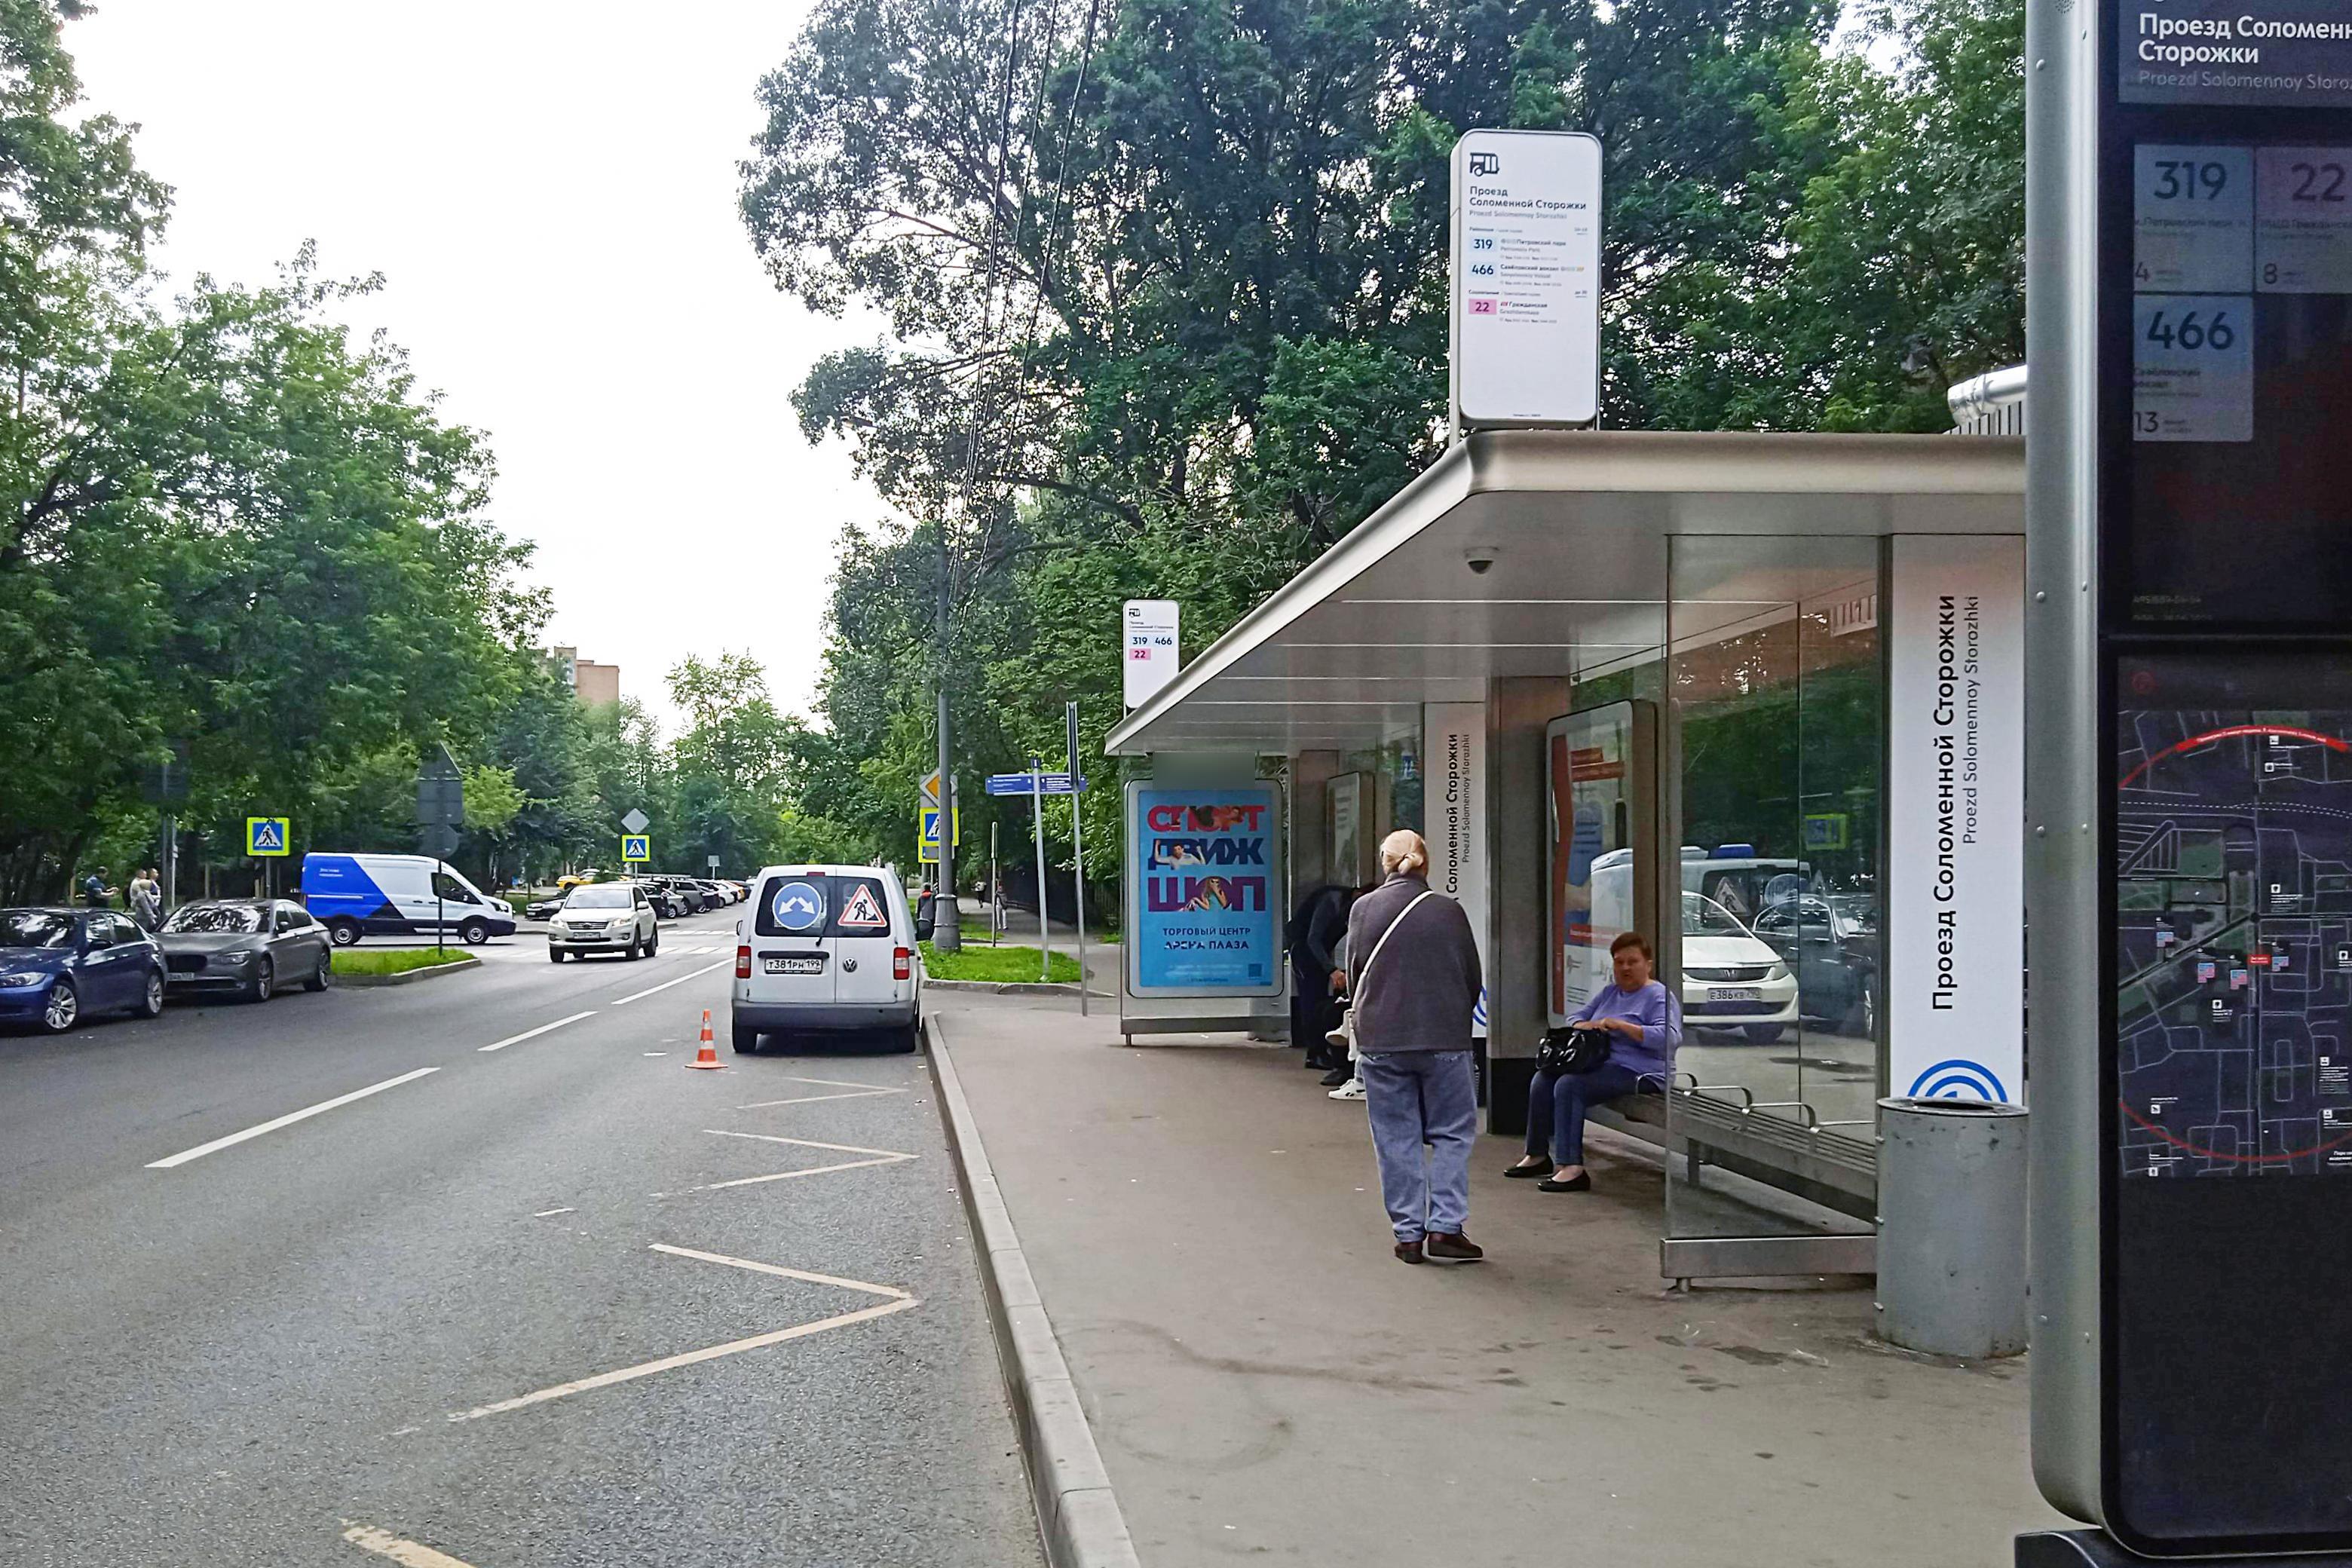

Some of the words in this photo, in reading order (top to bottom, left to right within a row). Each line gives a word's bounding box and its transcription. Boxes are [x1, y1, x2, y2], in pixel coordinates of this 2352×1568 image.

[2139, 13, 2231, 40] Проезд
[2138, 39, 2259, 66] Сторожки
[2139, 70, 2197, 87] Proezd
[2202, 71, 2303, 92] Solomennoy
[1470, 186, 1508, 197] Проезд
[2154, 161, 2228, 200] 319
[2290, 162, 2346, 202] 22
[1469, 197, 1533, 207] Соломенной
[1536, 200, 1586, 210] Сторожки
[1474, 239, 1493, 250] 319
[1472, 265, 1493, 275] 466
[2134, 262, 2149, 282] 4
[2263, 263, 2278, 284] 8
[1475, 302, 1490, 312] 22
[2147, 311, 2235, 350] 466
[2133, 412, 2160, 433] 13
[1132, 636, 1147, 645] 319
[1155, 637, 1172, 645] 466
[1963, 596, 1978, 674] Storozhki
[1135, 651, 1145, 659] 22
[1933, 595, 1958, 726] Сторожки
[1963, 680, 1982, 782] Solomennoy
[1446, 734, 1460, 802] Сторожки
[1147, 804, 1266, 832] СПОРТ
[1462, 779, 1471, 830] Solomennoy
[1963, 788, 1977, 844] Proezd
[1933, 735, 1955, 903] Соломенной
[1446, 807, 1458, 893] Соломенной
[1462, 833, 1470, 863] Proezd
[1162, 927, 1216, 936] ТОРГОВЫЙ
[1219, 927, 1251, 936] ЦЕНТР
[1208, 940, 1249, 950] ПЛАЗА
[1932, 909, 1957, 1011] Проезд
